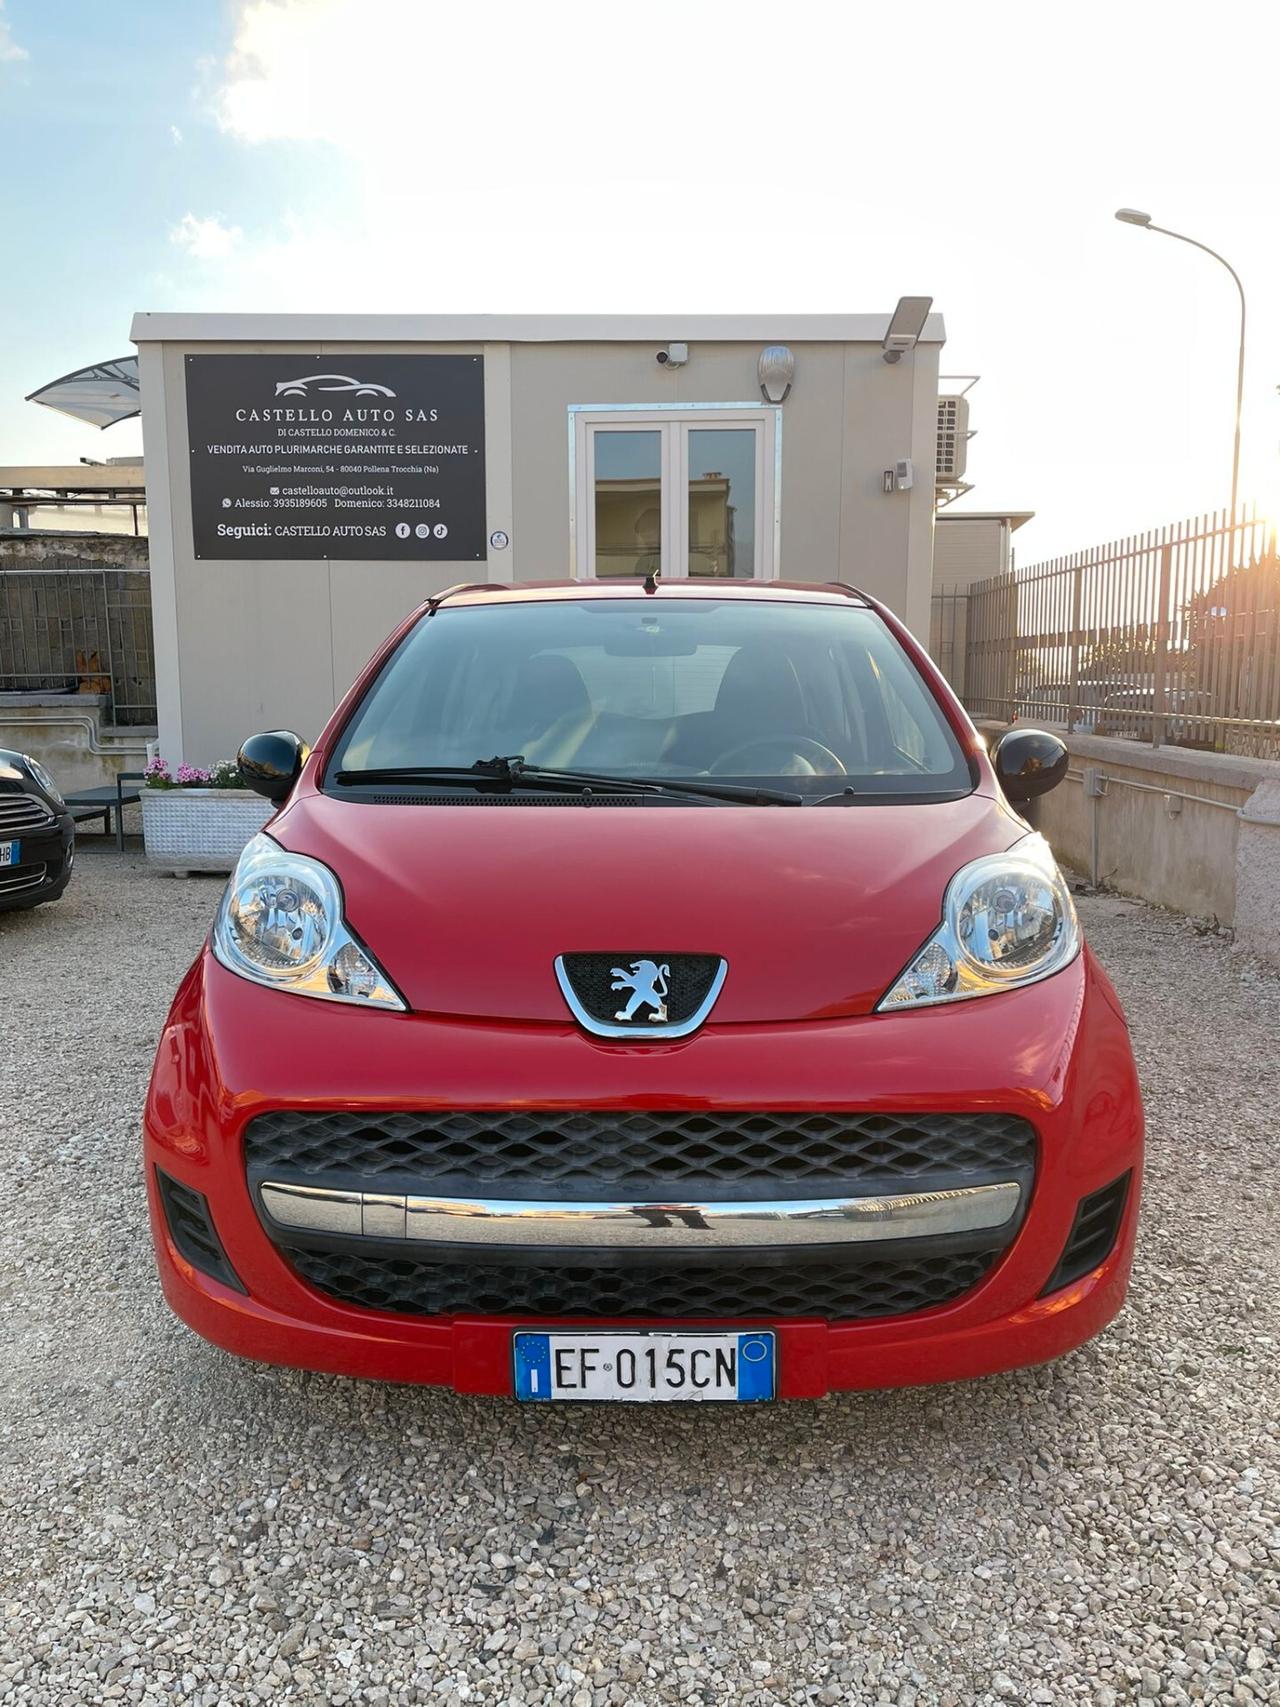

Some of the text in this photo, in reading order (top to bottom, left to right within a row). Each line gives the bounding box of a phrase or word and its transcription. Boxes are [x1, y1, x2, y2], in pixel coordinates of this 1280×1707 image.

[236, 409, 438, 421] CASTELLO AUTO SAS
[277, 428, 287, 437] DI
[288, 428, 332, 437] CASTELLO
[333, 428, 380, 437] DOMENICO
[381, 428, 387, 437] &
[207, 445, 468, 454] VENDITA AUTO PLURIMARCHE GARANTITE E SELEZIONATE
[242, 465, 255, 473] Via
[256, 465, 292, 475] Guglielmo
[293, 465, 324, 474] Marconi,
[325, 465, 335, 473] 54
[340, 465, 362, 473] 80040
[363, 465, 390, 473] Pollena
[391, 465, 423, 473] Trocchia
[423, 465, 439, 474] (Na)
[282, 486, 394, 497] castelloauto@outlook.it
[235, 499, 440, 508] Alessio: 3935189605 Domenico: 3348211084
[217, 523, 387, 539] Seguici: CASTELLO AUTO SAS
